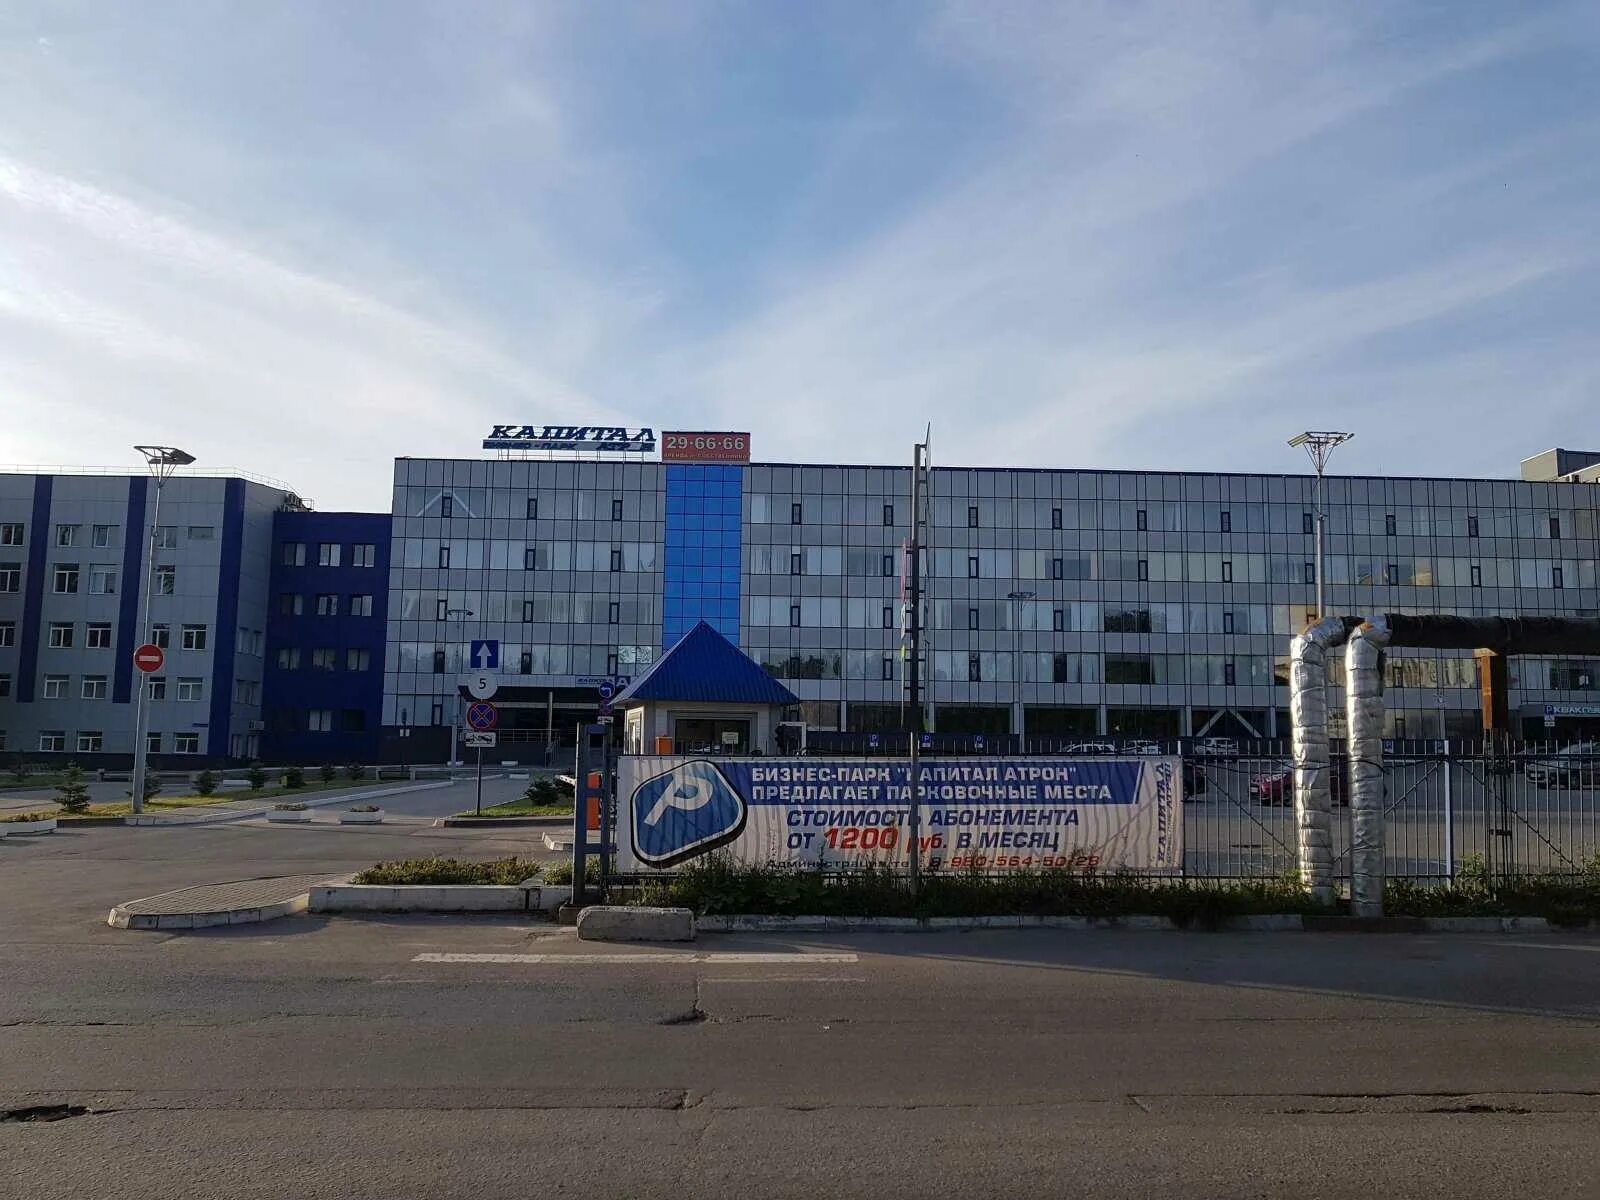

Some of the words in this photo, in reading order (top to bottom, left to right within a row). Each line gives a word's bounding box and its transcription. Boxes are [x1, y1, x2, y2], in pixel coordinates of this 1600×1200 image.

[488, 425, 656, 441] КАПИТАЛ
[479, 677, 486, 690] 5
[752, 767, 891, 781] БИЗНЕС-ПАРК
[1004, 767, 1077, 781] АТРОН"
[752, 786, 880, 802] ПРЕДЛАГАЕТ
[1044, 786, 1112, 799] МЕСТА
[928, 809, 1080, 826] АБОНЕМЕНТА
[1156, 762, 1167, 861] КАПИТАЛ
[787, 833, 815, 849] ОТ
[824, 828, 899, 849] 1200
[956, 832, 971, 849] В
[979, 832, 1060, 851] МЕСЯЦ
